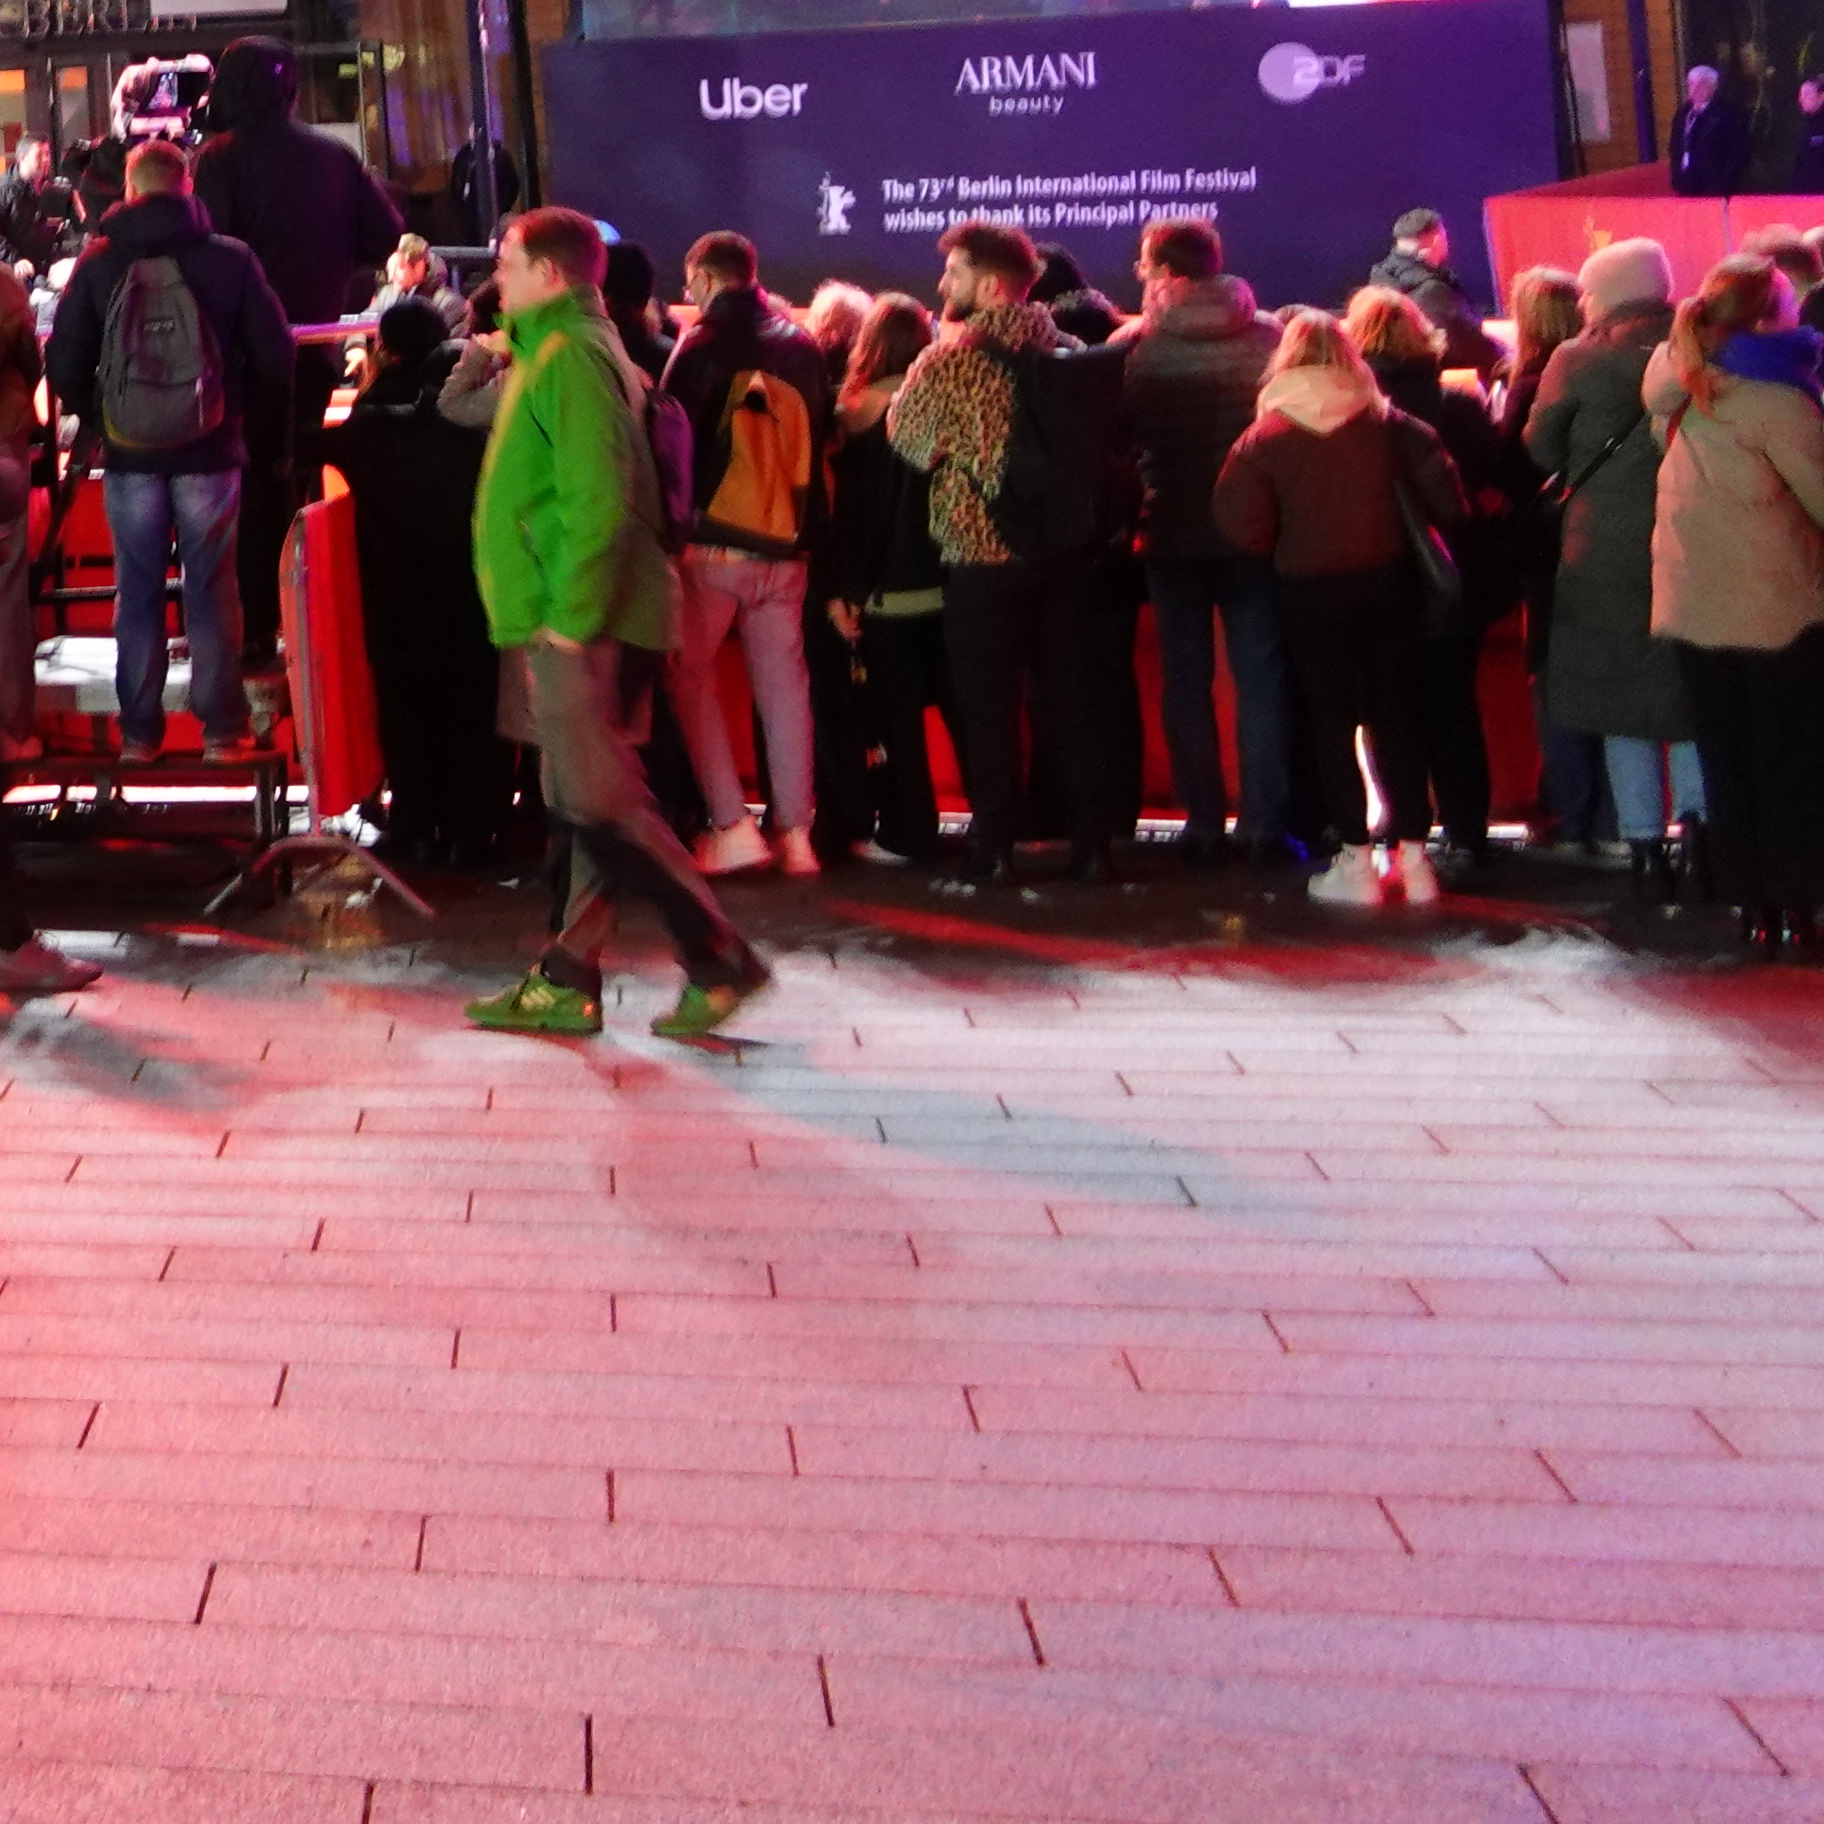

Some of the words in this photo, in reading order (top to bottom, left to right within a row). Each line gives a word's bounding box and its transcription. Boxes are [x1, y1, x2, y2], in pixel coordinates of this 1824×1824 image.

[954, 51, 1097, 95] ARMANI
[1292, 54, 1366, 88] ZDF
[699, 77, 809, 120] Uber
[989, 94, 1065, 116] beauty
[881, 178, 915, 203] The
[918, 174, 955, 203] 73rd
[957, 174, 1013, 201] Berlin
[1015, 170, 1137, 198] International
[1140, 168, 1182, 195] Film
[1184, 165, 1257, 194] Festival
[884, 207, 947, 234] wishes
[948, 207, 968, 230] to
[971, 204, 1026, 228] thank
[1027, 203, 1052, 229] its
[1054, 199, 1136, 231] Principal
[1137, 198, 1220, 227] Partners
